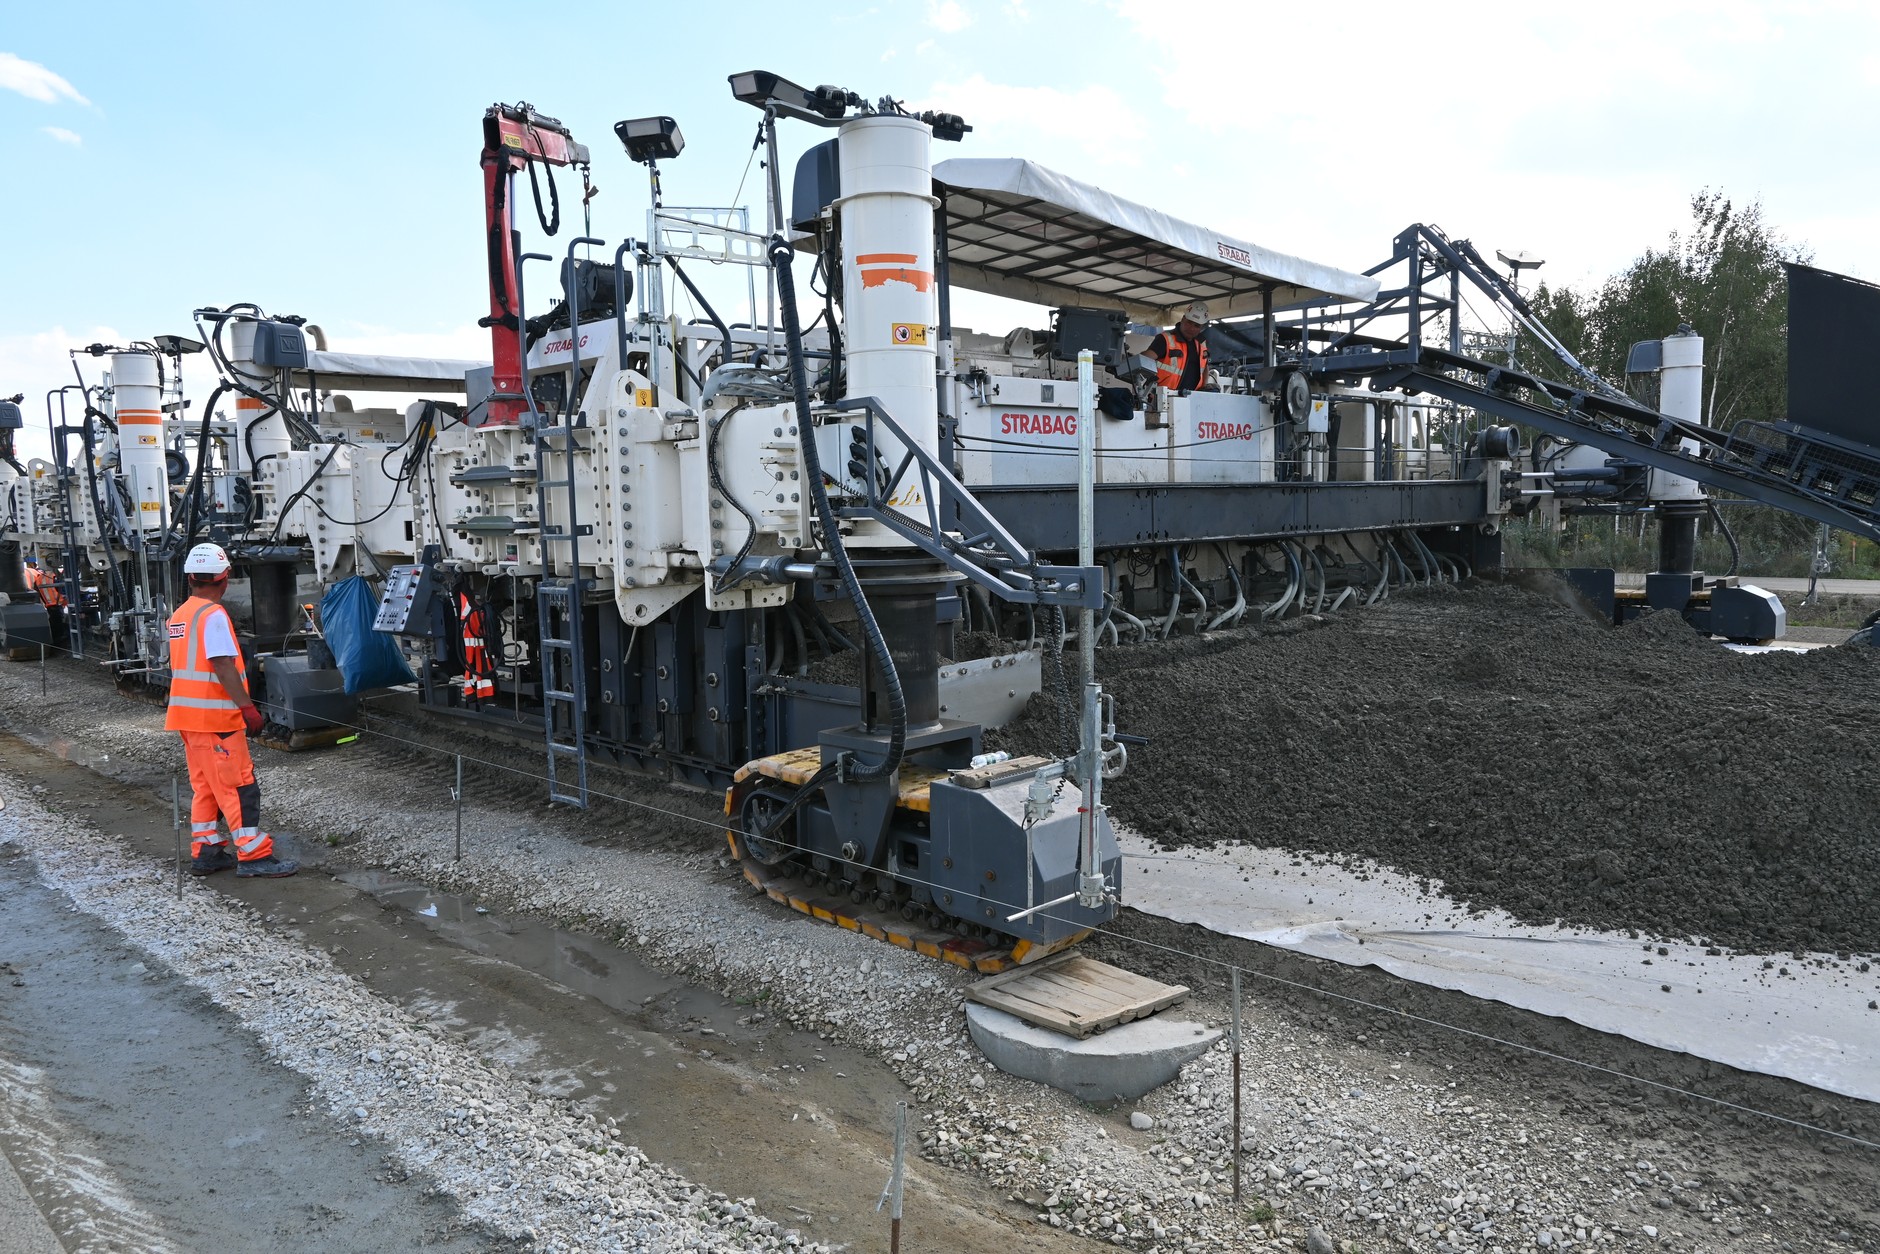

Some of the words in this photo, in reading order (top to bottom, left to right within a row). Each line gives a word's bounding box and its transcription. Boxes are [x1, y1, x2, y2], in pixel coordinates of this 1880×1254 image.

[1218, 245, 1251, 265] STRABAG
[544, 335, 588, 355] STRABG
[1001, 413, 1077, 436] STRABAG
[1198, 421, 1252, 441] STRABAG
